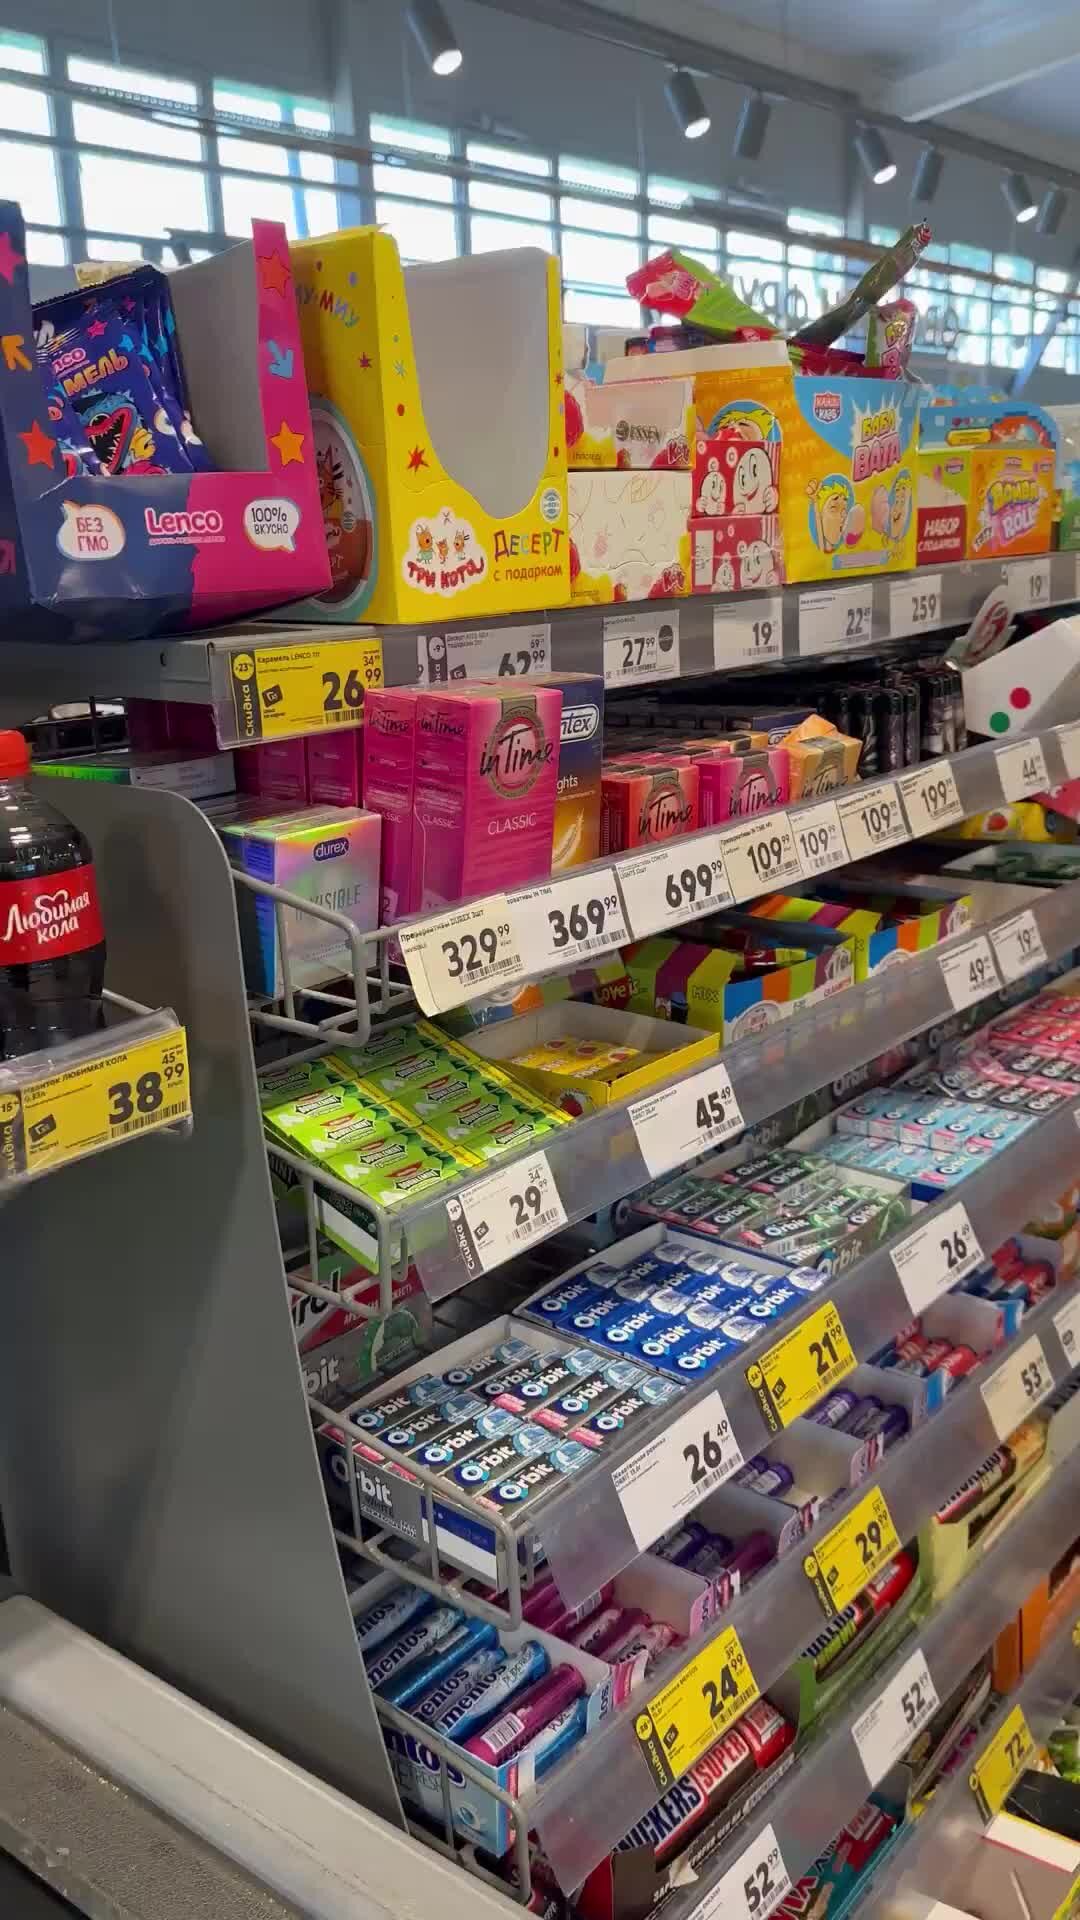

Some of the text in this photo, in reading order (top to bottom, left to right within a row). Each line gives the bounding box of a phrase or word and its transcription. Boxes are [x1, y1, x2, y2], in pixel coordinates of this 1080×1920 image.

[76, 516, 104, 533] БЕЗ
[145, 508, 223, 535] Lenco
[251, 507, 288, 523] 100%
[254, 523, 289, 535] ВКУСНО
[78, 534, 109, 552] ГМО
[493, 528, 565, 562] ДЕСЕРТ
[407, 557, 485, 589] ТРИ КОТА
[505, 564, 562, 582] подарком
[846, 608, 863, 637] 22
[912, 594, 937, 623] 259
[752, 622, 772, 647] 19
[532, 650, 546, 663] 99
[622, 637, 646, 669] 27
[322, 668, 382, 711] 26 99
[920, 781, 947, 813] 199
[488, 812, 537, 836] CLASSIC
[860, 804, 891, 837] 109
[315, 839, 348, 858] durex
[747, 836, 782, 875] 109
[800, 828, 829, 859] 109
[665, 860, 723, 909] 699 99
[2, 890, 91, 943] Любимая
[36, 918, 80, 945] кола
[547, 895, 618, 948] 369 99
[441, 923, 511, 978] 329 99
[969, 958, 985, 983] 49
[62, 1062, 104, 1082] ЛЮБИМАЯ
[105, 1054, 129, 1070] КОЛА
[161, 1053, 176, 1066] 45
[108, 1063, 185, 1125] 38 99
[696, 1086, 731, 1128] 45 49
[509, 1186, 542, 1226] 29
[765, 1218, 811, 1237] Orbit
[939, 1232, 967, 1268] 26
[542, 1284, 588, 1312] Orbit
[574, 1297, 620, 1328] Orbit
[750, 1286, 795, 1317] Orbit
[607, 1311, 655, 1342] Orbit
[642, 1324, 691, 1355] Orbit
[678, 1337, 727, 1369] Orbit
[808, 1331, 839, 1376] 21
[448, 1355, 498, 1384] Orbit
[485, 1366, 535, 1395] Orbit
[522, 1366, 570, 1397] Orbit
[1021, 1361, 1042, 1397] 53
[357, 1395, 411, 1428] Orbit
[561, 1379, 609, 1412] Orbit
[388, 1412, 443, 1445] Orbit
[597, 1396, 645, 1430] Orbit
[425, 1428, 480, 1462] Orbit
[683, 1420, 729, 1485] 26 49
[461, 1444, 517, 1482] Orbit
[500, 1463, 554, 1500] Orbit
[855, 1520, 883, 1565] 29
[441, 1666, 507, 1730] mentos
[702, 1654, 744, 1719] 24 99
[902, 1681, 926, 1724] 52
[694, 1732, 748, 1793] SUPER
[1004, 1732, 1025, 1768] 72
[744, 1848, 779, 1913] 52 99
